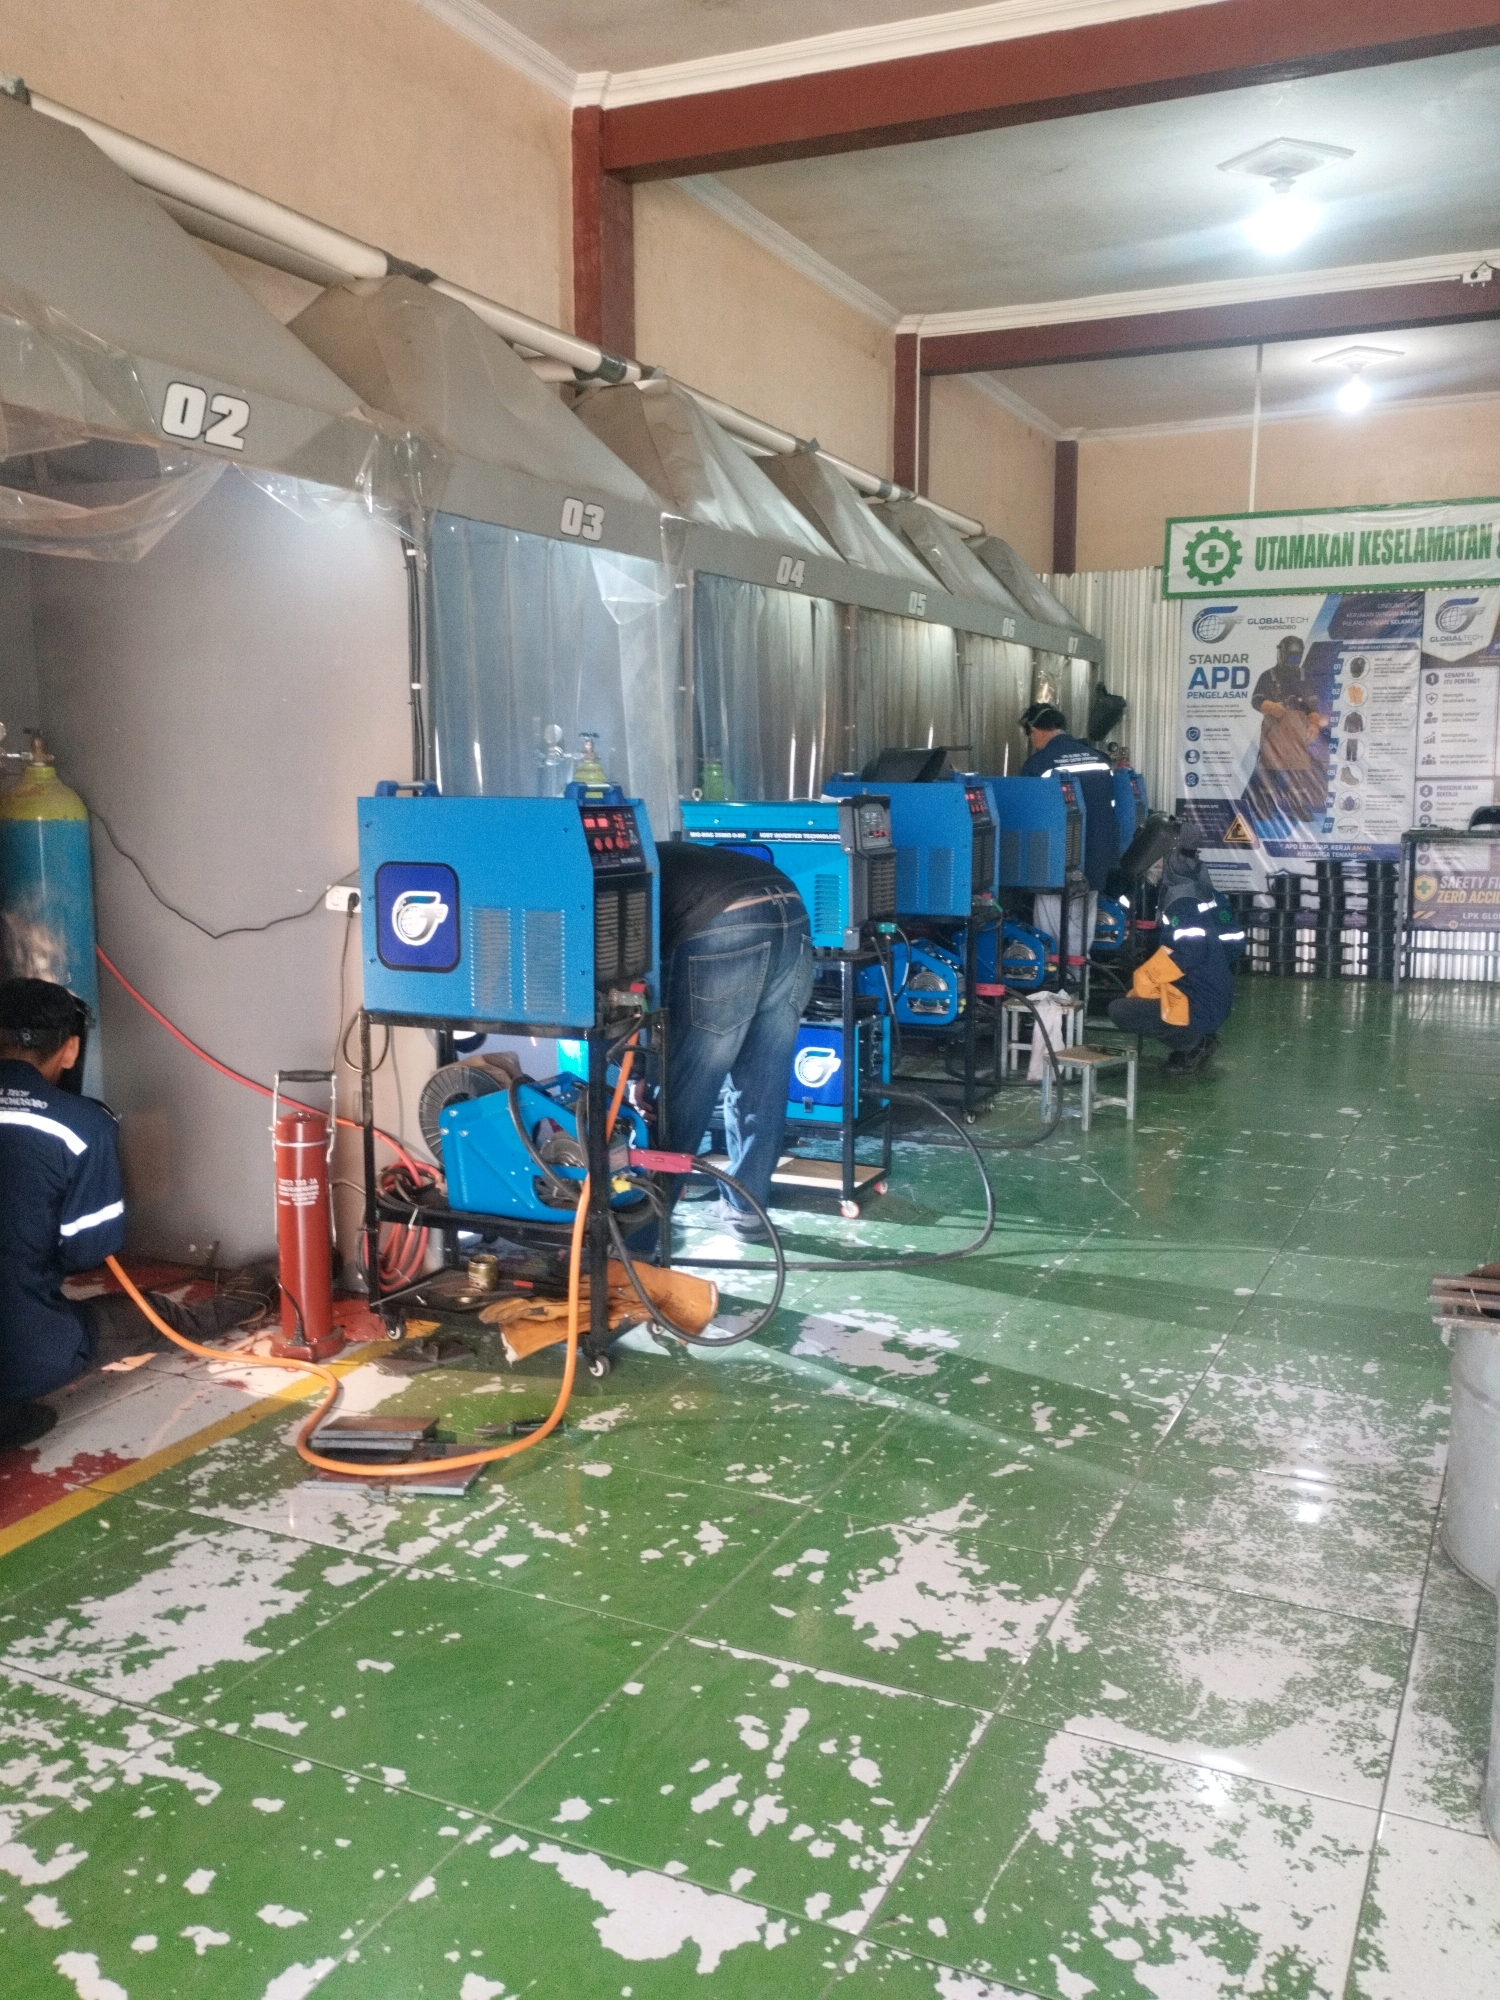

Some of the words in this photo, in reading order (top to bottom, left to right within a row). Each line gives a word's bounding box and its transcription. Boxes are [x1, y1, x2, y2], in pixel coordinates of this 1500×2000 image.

[161, 381, 250, 452] 02
[560, 497, 605, 542] 03
[1254, 532, 1355, 571] UTAMAKAN
[1358, 523, 1493, 566] KESELAMATAN
[776, 555, 806, 589] 04
[908, 590, 927, 617] 05
[1247, 616, 1309, 625] GLOBALTECH
[1002, 617, 1016, 639] 06
[1430, 634, 1484, 643] GLOBALTECH
[1188, 653, 1250, 665] STANDAR
[1188, 666, 1251, 690] APD
[1430, 675, 1435, 684] 1
[1187, 691, 1249, 700] PENGELASAN
[1423, 786, 1429, 795] 4
[1324, 821, 1333, 829] 07
[1440, 875, 1486, 889] SAFETY
[1437, 890, 1468, 904] ZERO
[1462, 912, 1480, 920] LPK
[1482, 912, 1500, 920] GLO
